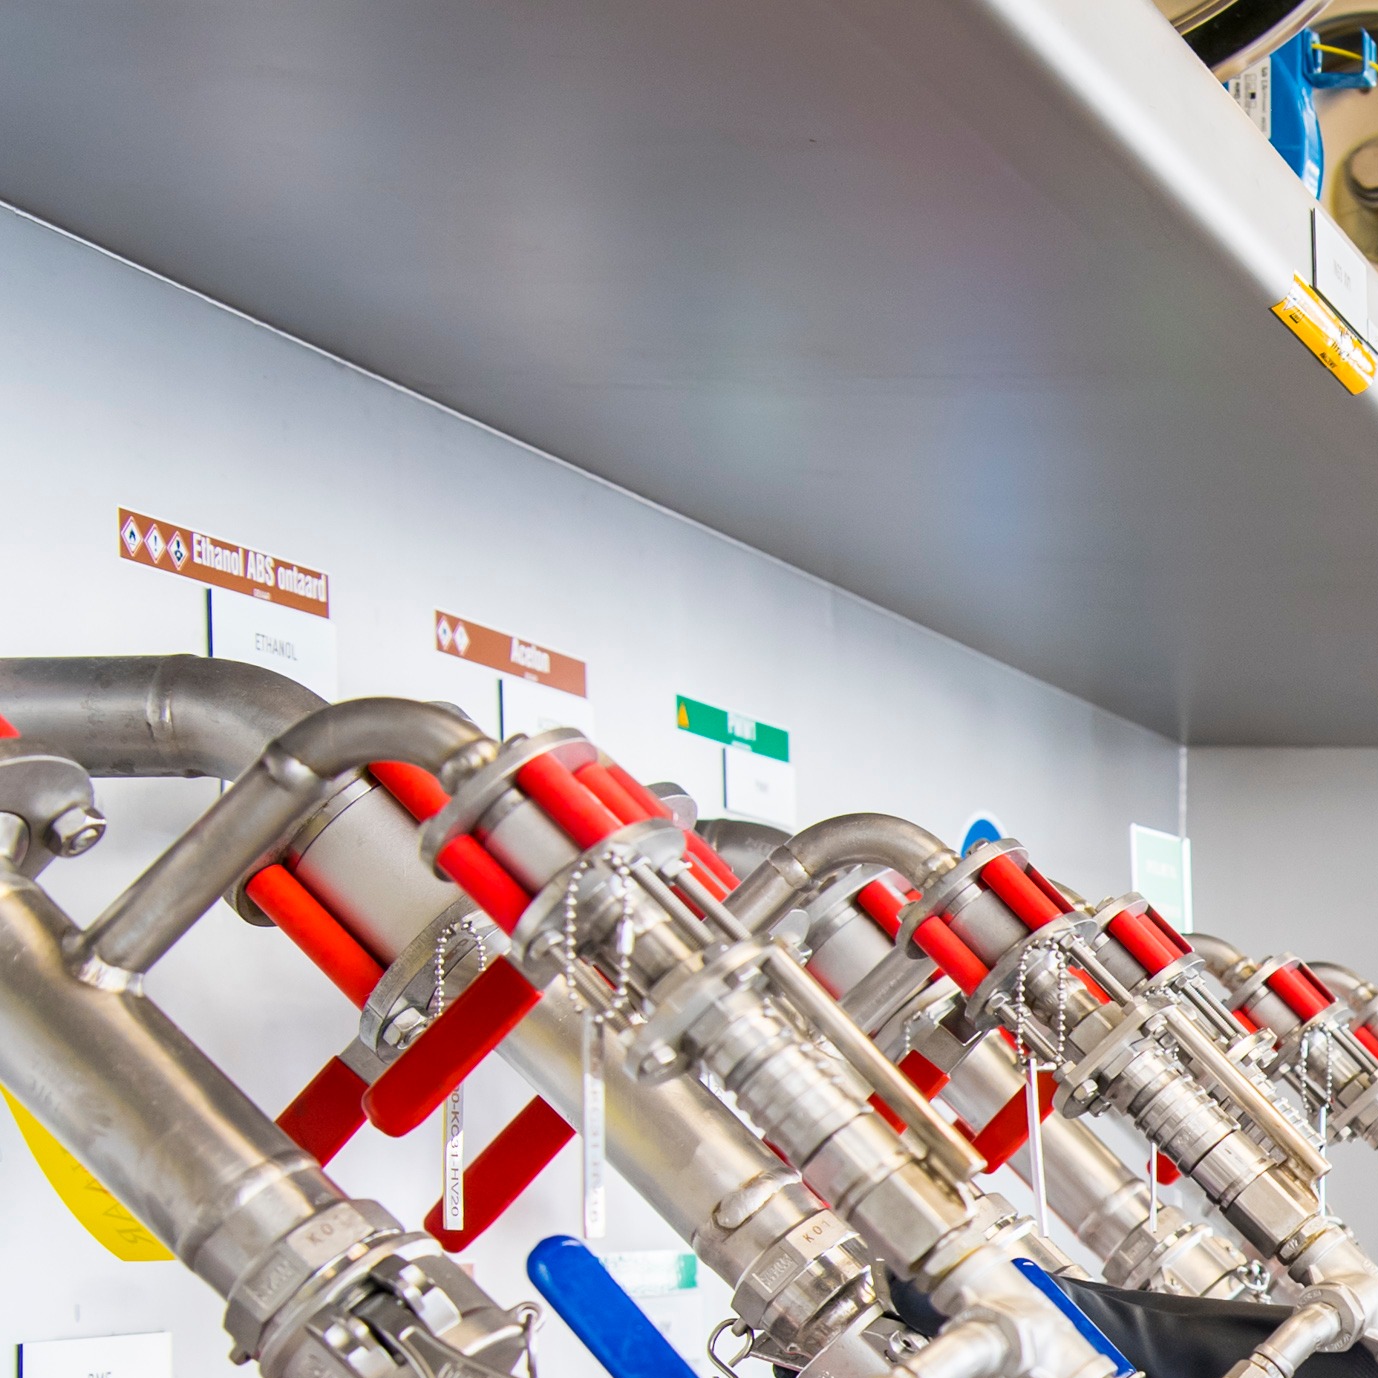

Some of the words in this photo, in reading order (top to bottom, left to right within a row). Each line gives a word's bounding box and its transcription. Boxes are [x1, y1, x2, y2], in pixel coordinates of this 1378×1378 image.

[192, 532, 244, 577] Ethanol
[247, 550, 275, 587] ABS
[277, 565, 328, 603] ontaard
[255, 633, 298, 661] ETHANOL
[451, 1085, 460, 1217] 0-KC31-HV20
